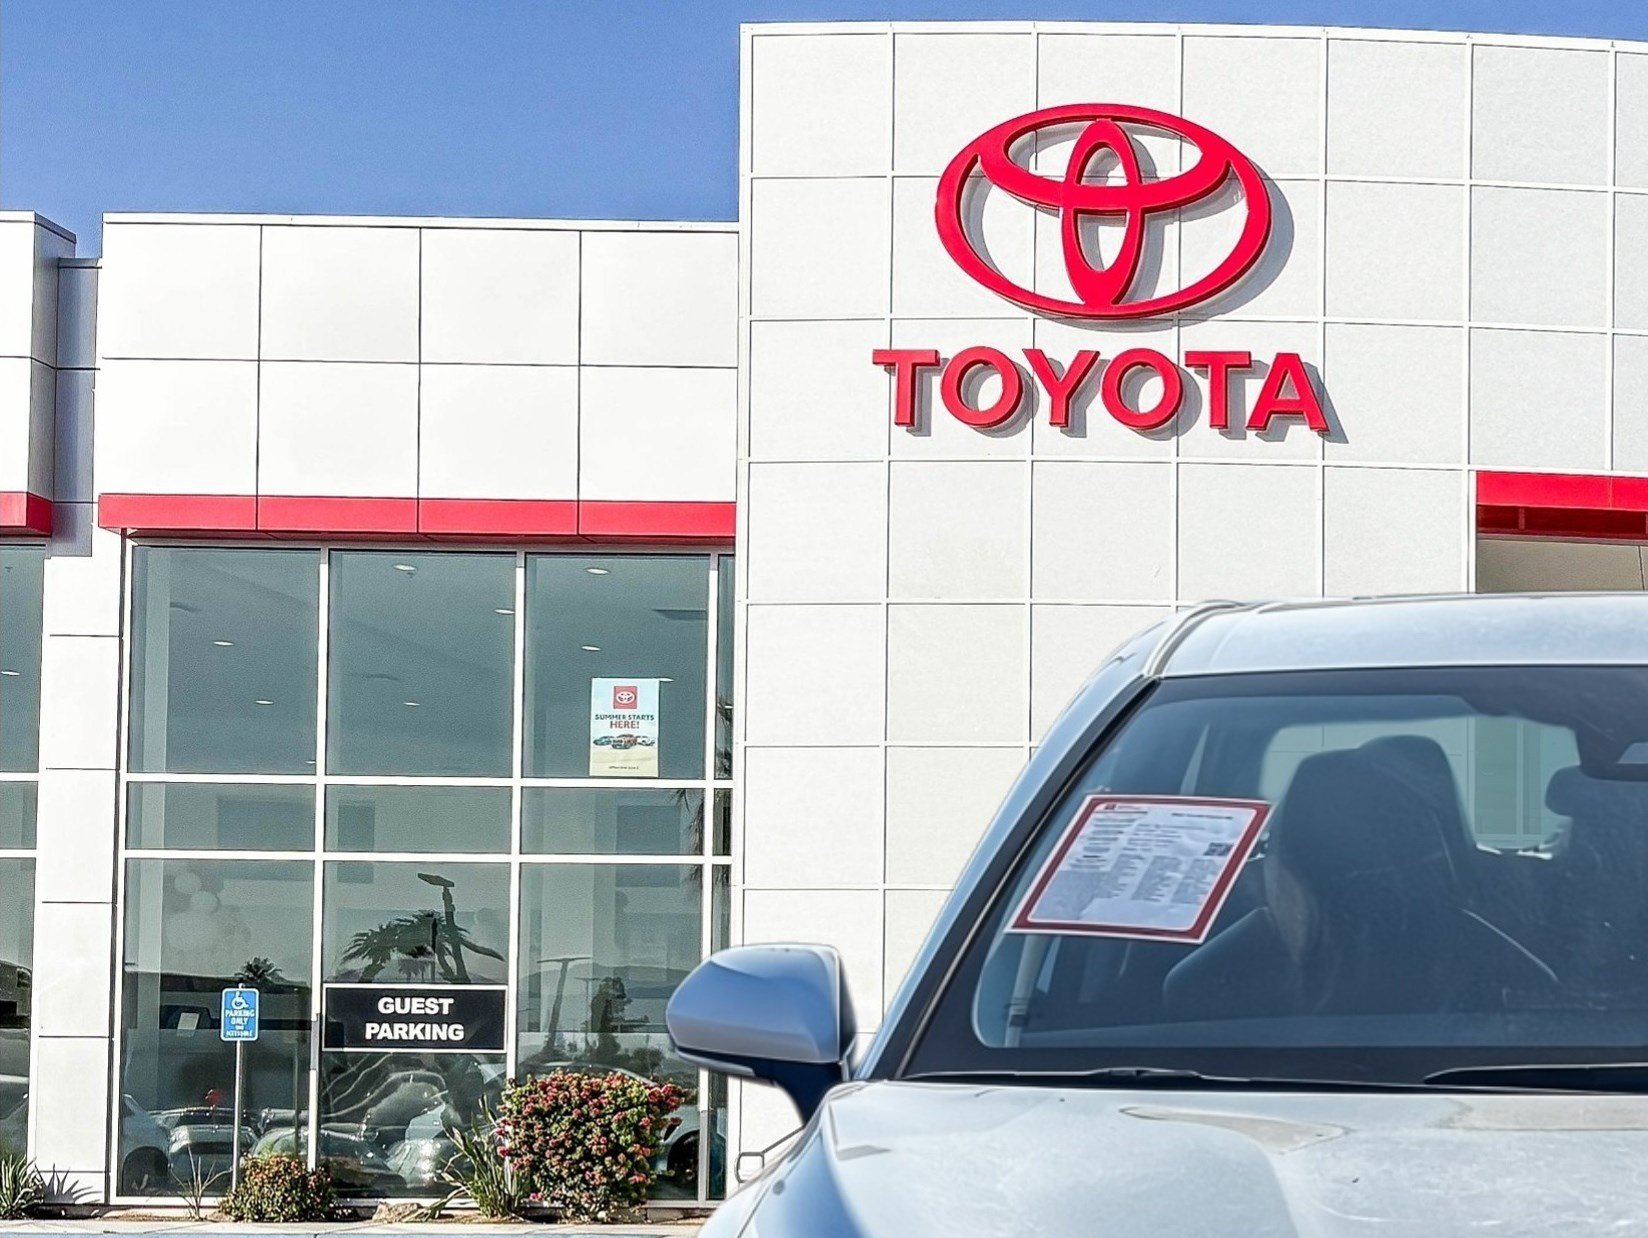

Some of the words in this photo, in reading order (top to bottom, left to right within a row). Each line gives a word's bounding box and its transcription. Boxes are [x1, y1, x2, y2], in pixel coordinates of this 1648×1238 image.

[873, 345, 1331, 432] TOYOTA
[610, 720, 640, 729] HERE!
[377, 997, 454, 1015] GUEST
[230, 1017, 249, 1025] ONLY
[364, 1022, 465, 1041] PARKING
